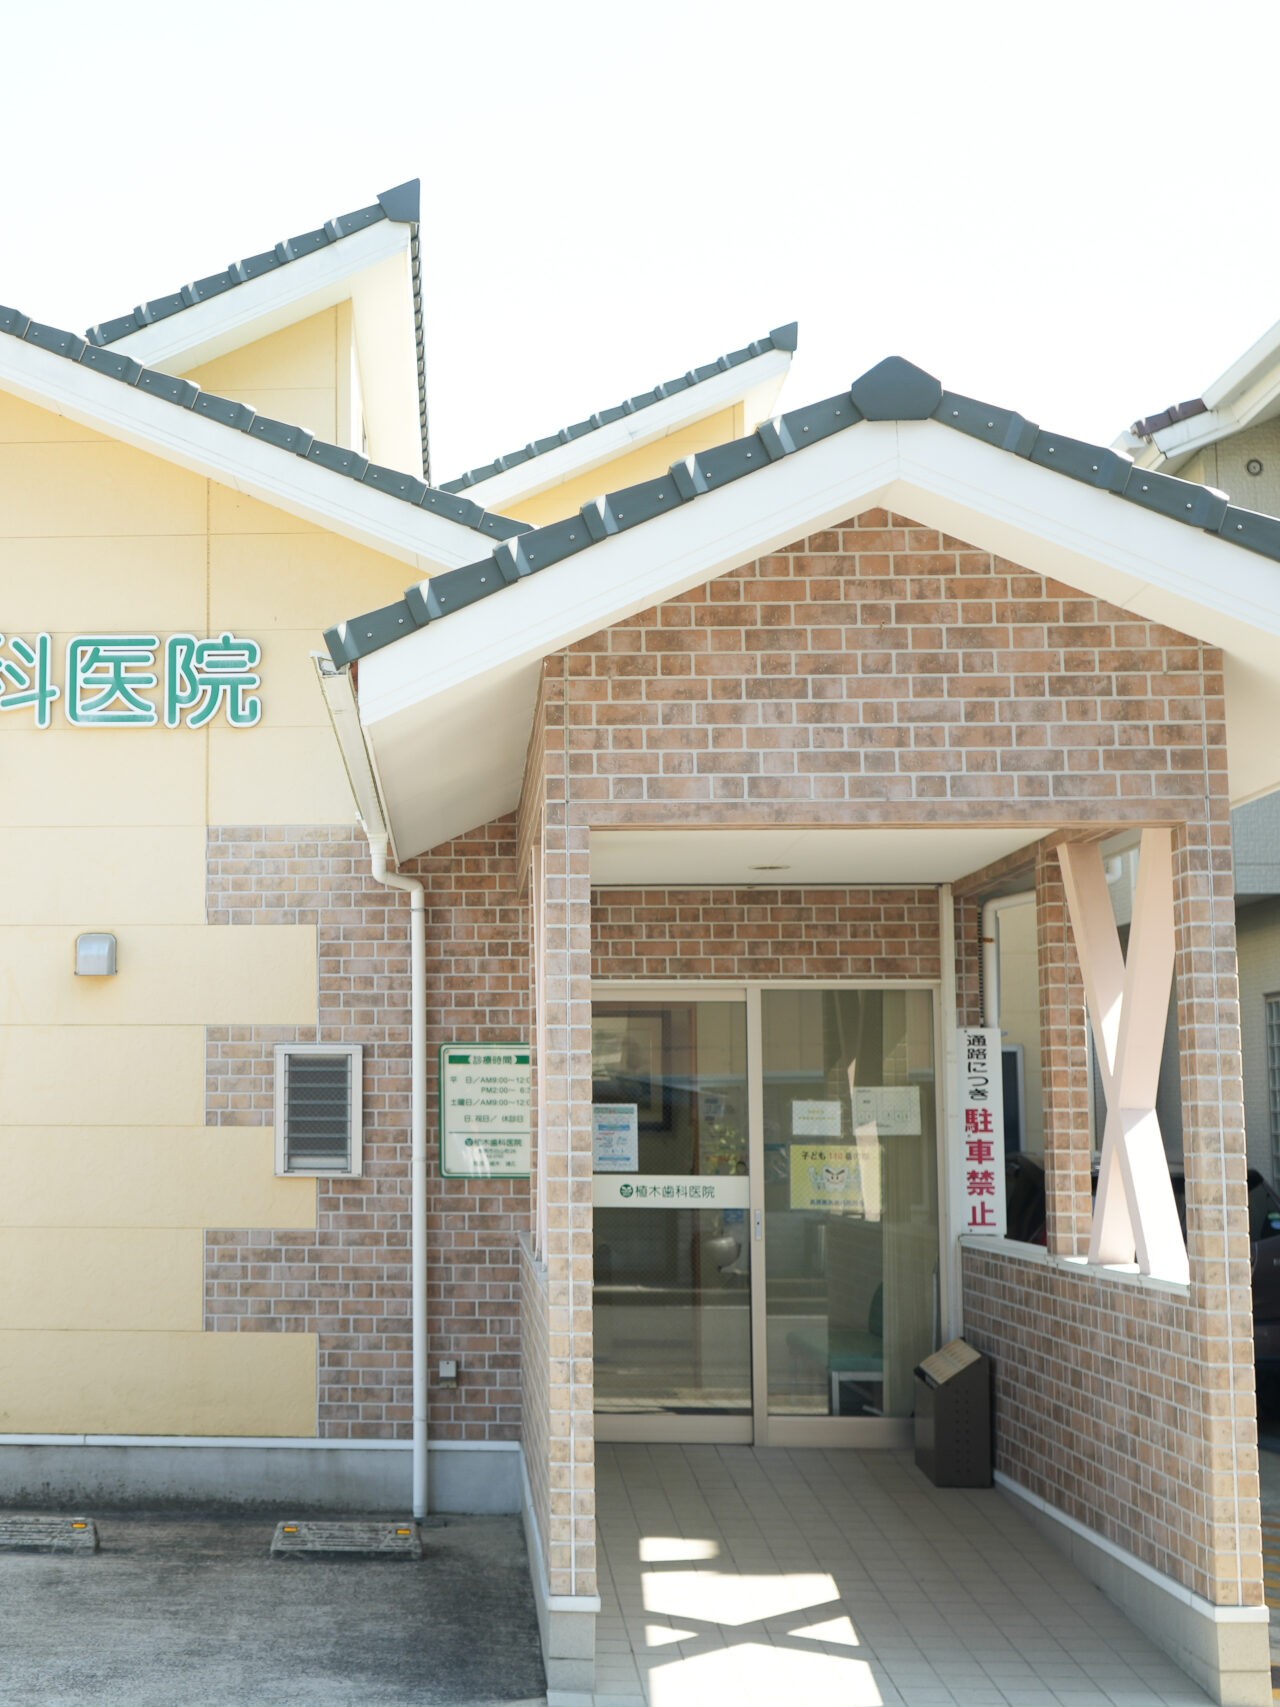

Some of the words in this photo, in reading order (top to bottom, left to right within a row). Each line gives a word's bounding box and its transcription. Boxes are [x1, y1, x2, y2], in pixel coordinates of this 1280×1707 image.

[472, 1055, 512, 1064] 診療時間
[966, 1034, 989, 1101] 通路につき
[965, 1108, 996, 1227] 駐車禁止
[635, 1184, 715, 1199] 植木歯科医院
